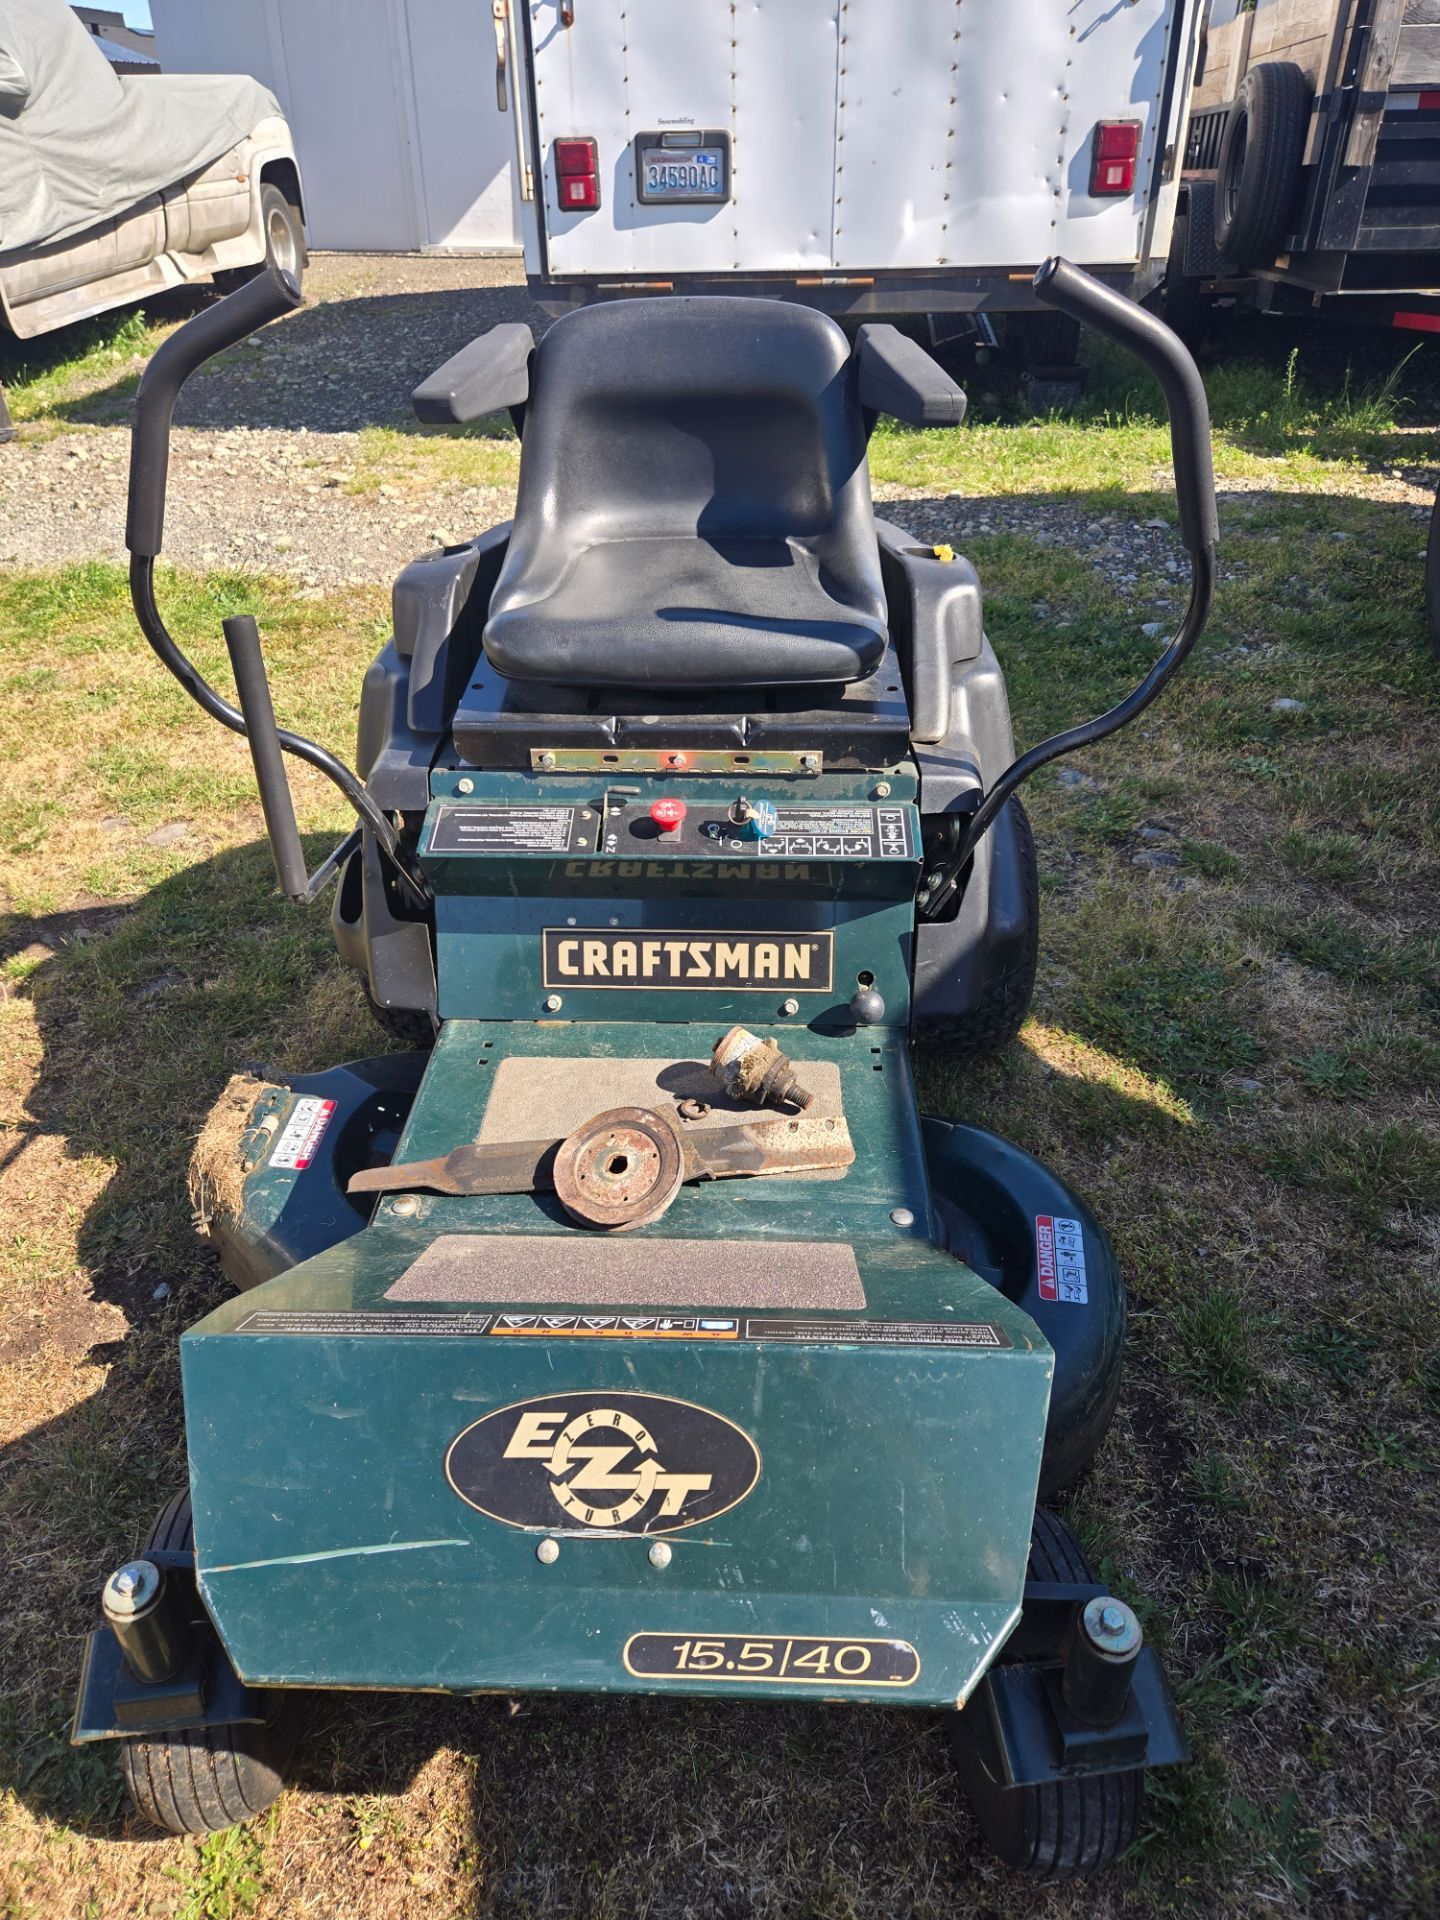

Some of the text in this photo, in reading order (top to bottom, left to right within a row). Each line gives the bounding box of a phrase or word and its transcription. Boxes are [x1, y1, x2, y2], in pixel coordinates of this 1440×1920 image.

[649, 166, 718, 188] 34590AC
[558, 940, 811, 979] CRAFTSMAN
[299, 1117, 328, 1161] DANGER
[1039, 1225, 1055, 1277] DANGER
[563, 1413, 647, 1443] ZERO
[564, 1493, 645, 1523] TURN
